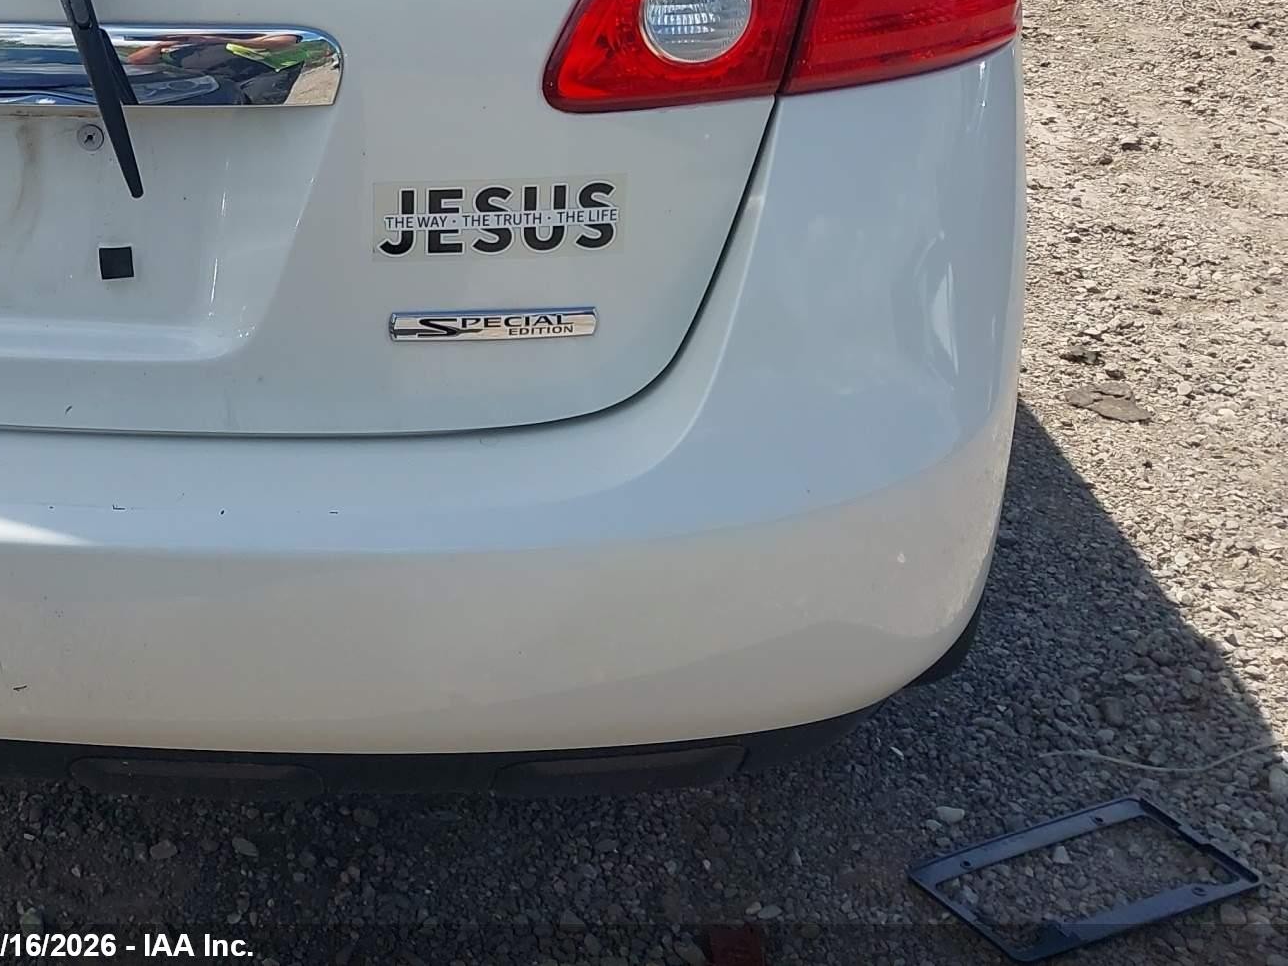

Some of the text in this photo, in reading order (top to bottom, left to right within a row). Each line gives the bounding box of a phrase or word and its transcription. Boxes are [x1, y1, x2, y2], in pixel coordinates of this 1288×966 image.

[379, 182, 615, 255] JESUS
[385, 208, 618, 229] THE WAY THE TRUTH THE LIFE
[417, 313, 574, 337] SPECIAL
[508, 325, 574, 336] EDITION
